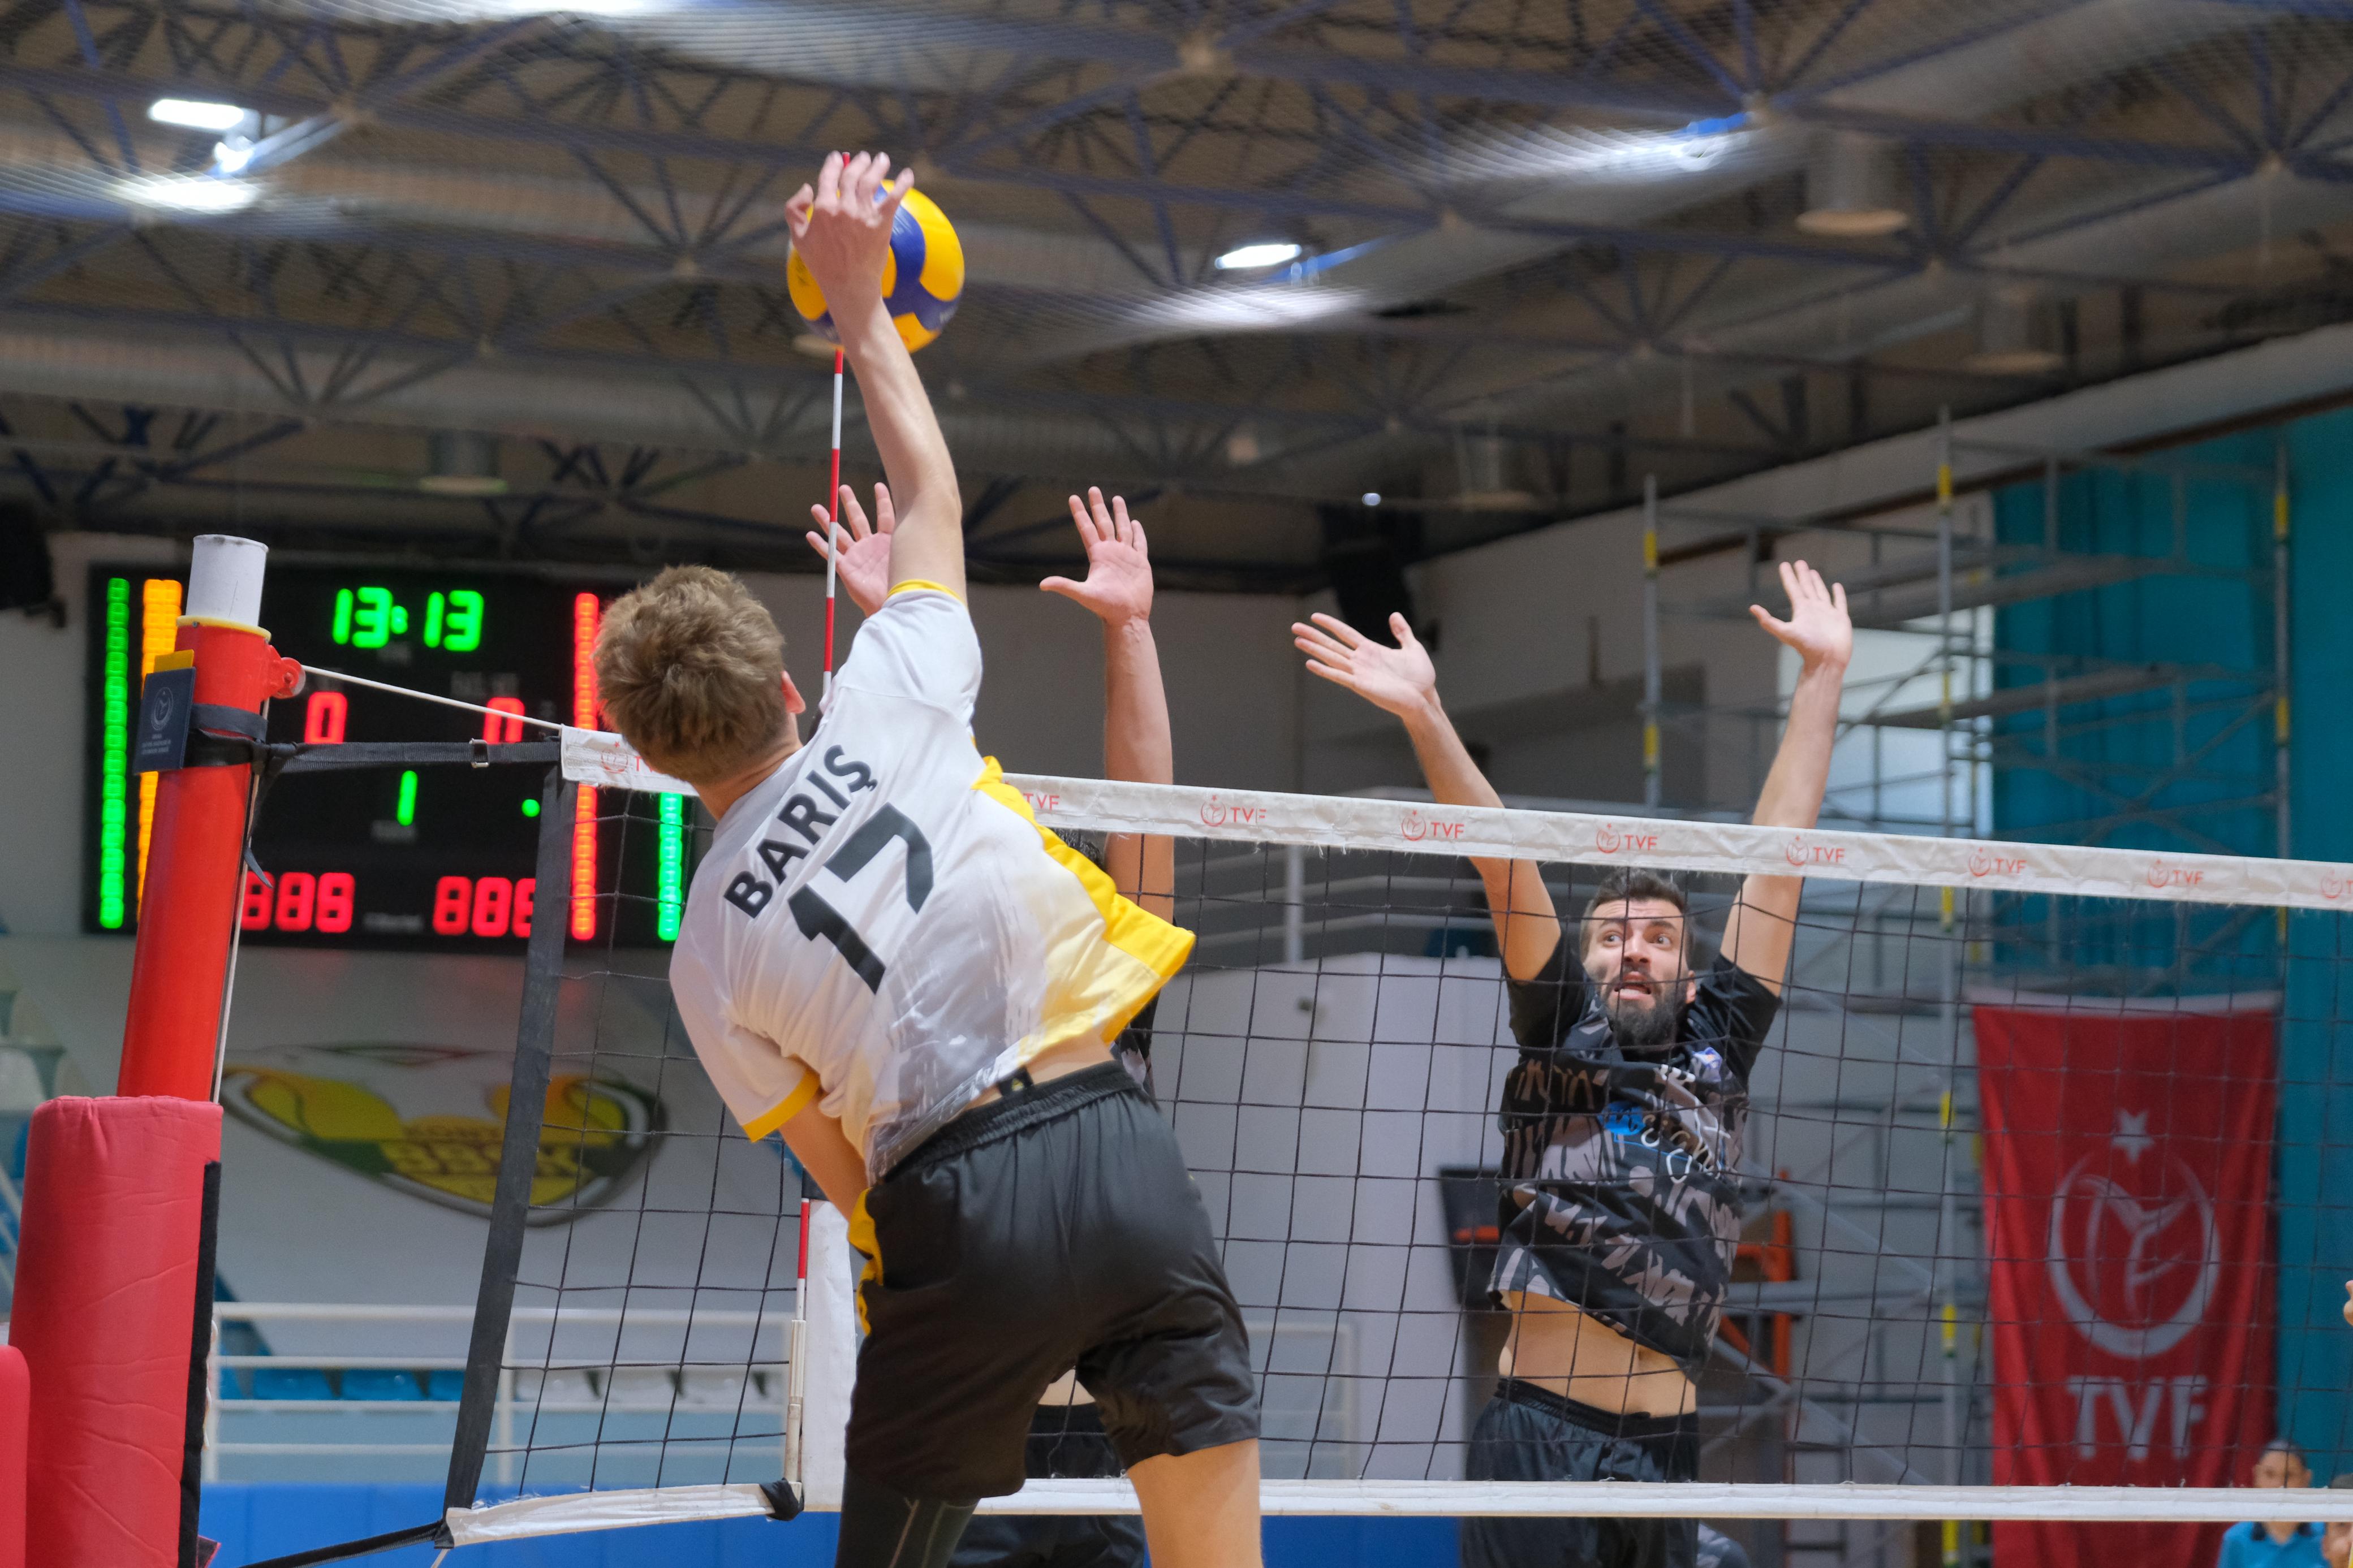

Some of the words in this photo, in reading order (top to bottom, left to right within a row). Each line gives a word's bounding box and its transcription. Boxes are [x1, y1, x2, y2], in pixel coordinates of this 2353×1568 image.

[305, 691, 348, 744] 0
[397, 770, 418, 826] 1
[1230, 806, 1267, 823] TVF
[724, 744, 878, 919] BARIŞ
[1430, 821, 1464, 839] TVF
[1624, 834, 1657, 851] TVF
[1813, 846, 1845, 863] TVF
[1995, 858, 2027, 874] TVF
[2173, 870, 2204, 885] TVF
[788, 801, 934, 995] 17
[2065, 1375, 2208, 1461] TVF
